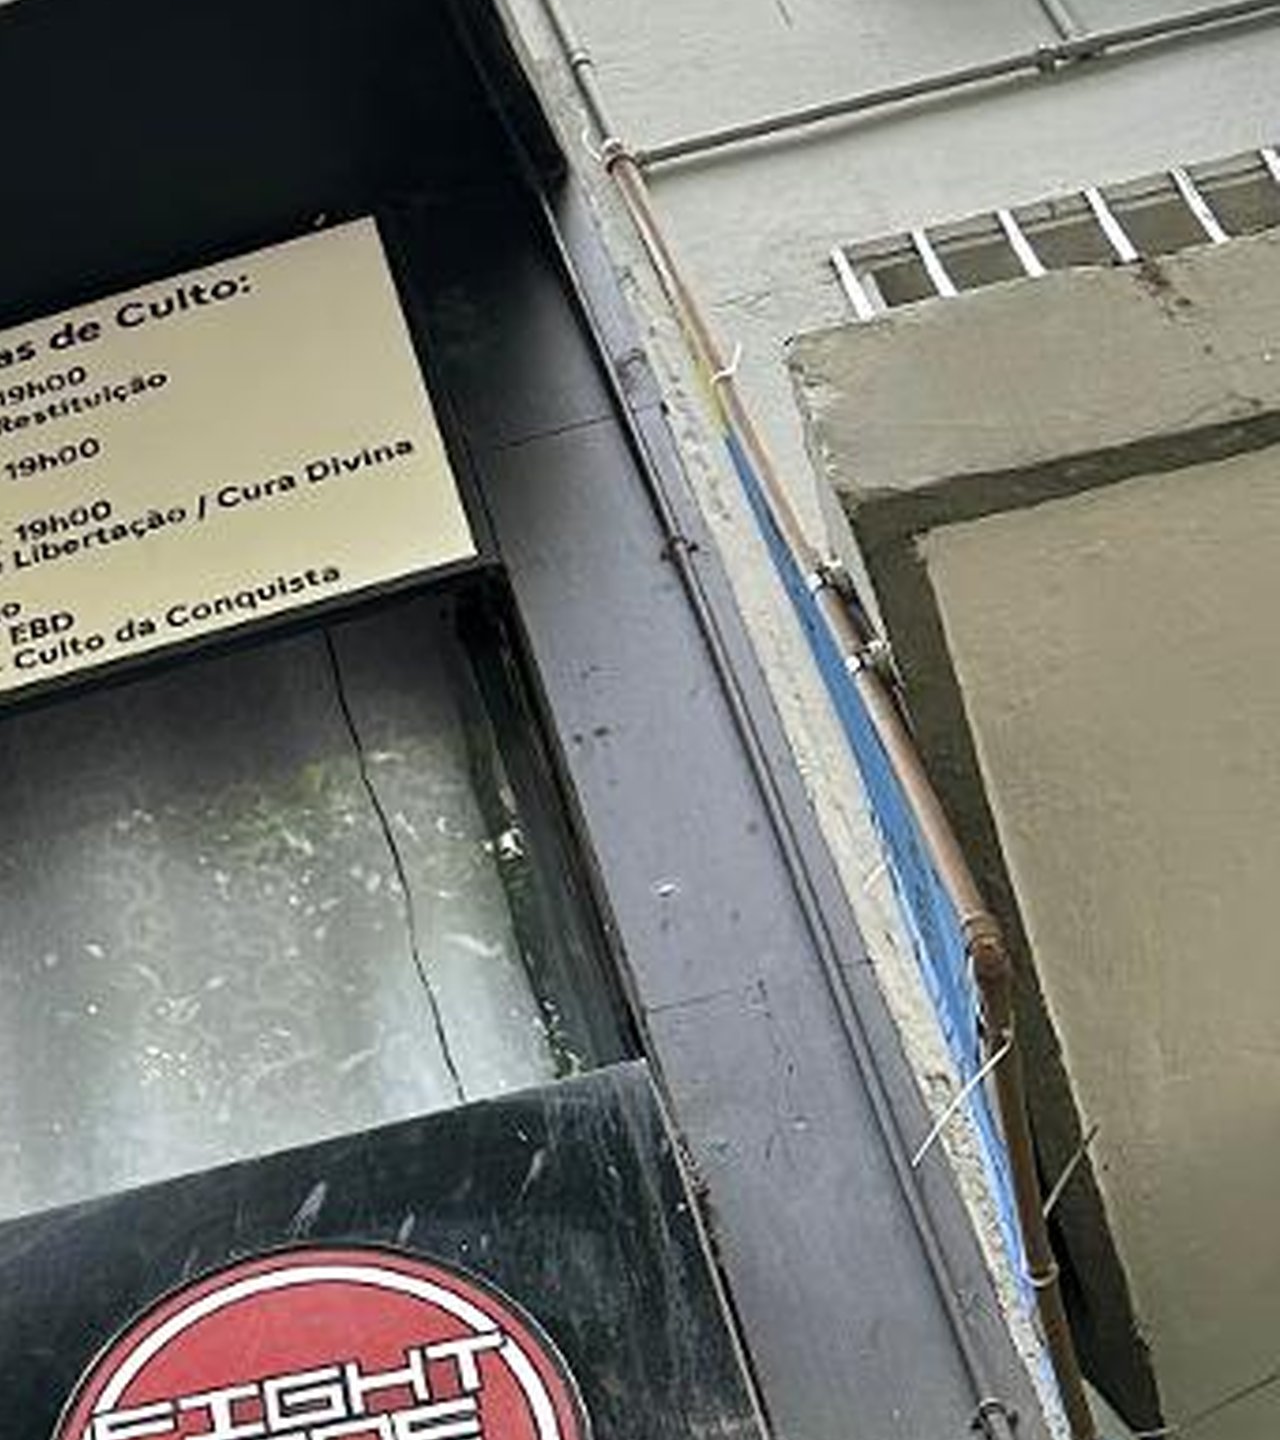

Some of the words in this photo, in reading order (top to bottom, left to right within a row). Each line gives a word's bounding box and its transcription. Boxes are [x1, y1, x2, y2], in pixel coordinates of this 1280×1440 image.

[48, 322, 101, 350] de
[114, 275, 251, 327] Culto:
[3, 437, 101, 480] 19h00
[13, 507, 187, 570] Libertação
[197, 494, 207, 521] /
[216, 473, 296, 509] Cura
[304, 438, 414, 484] Divina
[13, 500, 112, 542] 19h00
[9, 611, 75, 646] EBD
[13, 634, 106, 670] Culto
[115, 619, 156, 644] da
[165, 567, 341, 628] Conquista
